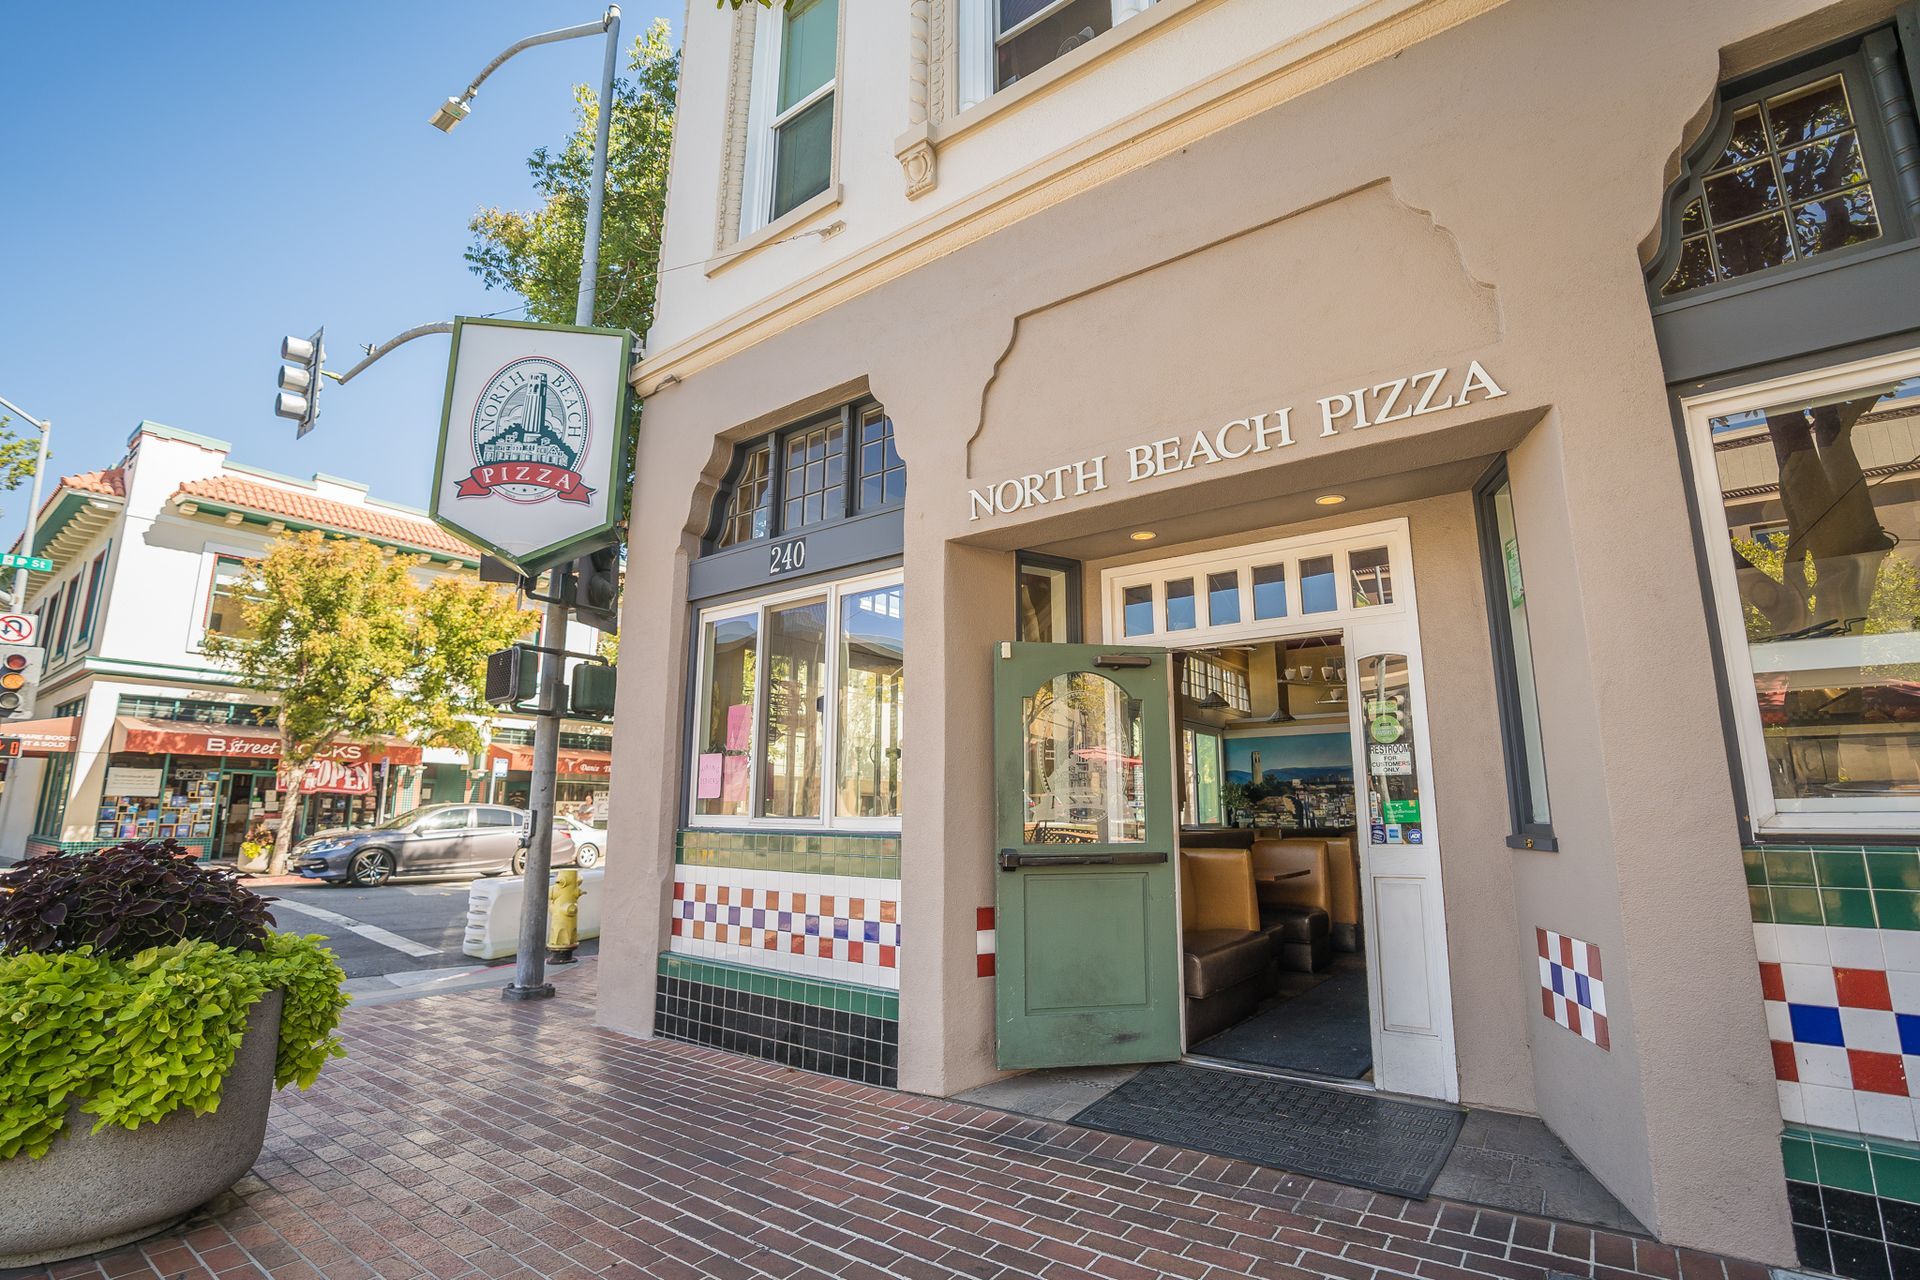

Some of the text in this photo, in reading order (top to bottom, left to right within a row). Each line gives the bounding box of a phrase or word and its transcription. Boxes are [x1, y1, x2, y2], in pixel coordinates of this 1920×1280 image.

[480, 371, 582, 438] NORTH BEACH
[969, 360, 1508, 521] NORTH BEACH PIZZA
[481, 466, 573, 491] PIZZA
[31, 559, 46, 569] St
[770, 541, 805, 574] 240
[206, 737, 226, 752] B
[228, 736, 280, 755] Street
[1370, 743, 1409, 754] RESTROOM
[316, 760, 371, 791] OPEN
[1371, 760, 1411, 768] CUSTOMERS
